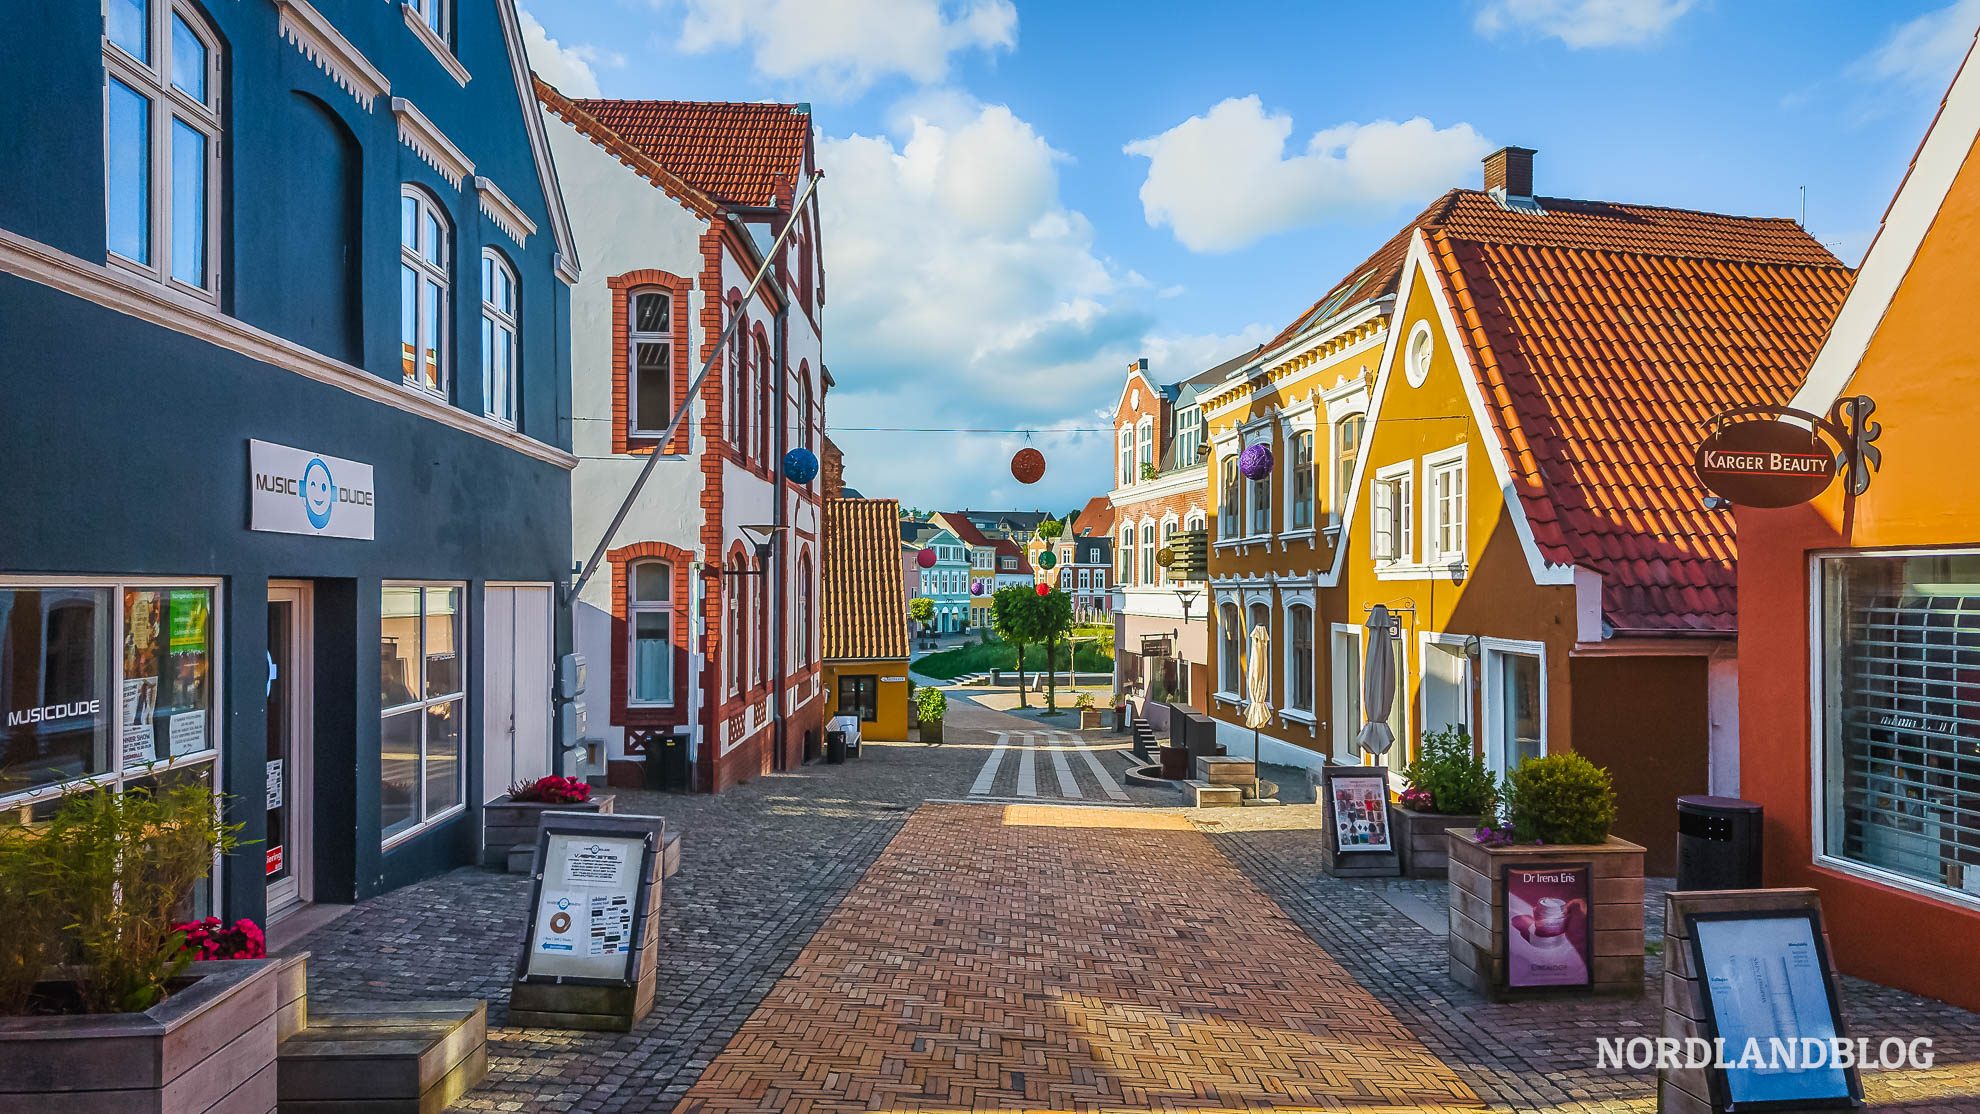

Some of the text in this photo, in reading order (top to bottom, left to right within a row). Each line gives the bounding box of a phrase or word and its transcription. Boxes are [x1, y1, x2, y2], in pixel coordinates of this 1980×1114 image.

[1704, 450, 1828, 472] KARGER BEAUTY
[256, 473, 373, 507] MUSIC DUDE
[8, 700, 100, 726] MUSICDUDE
[1523, 873, 1575, 883] Dr Irena Eris
